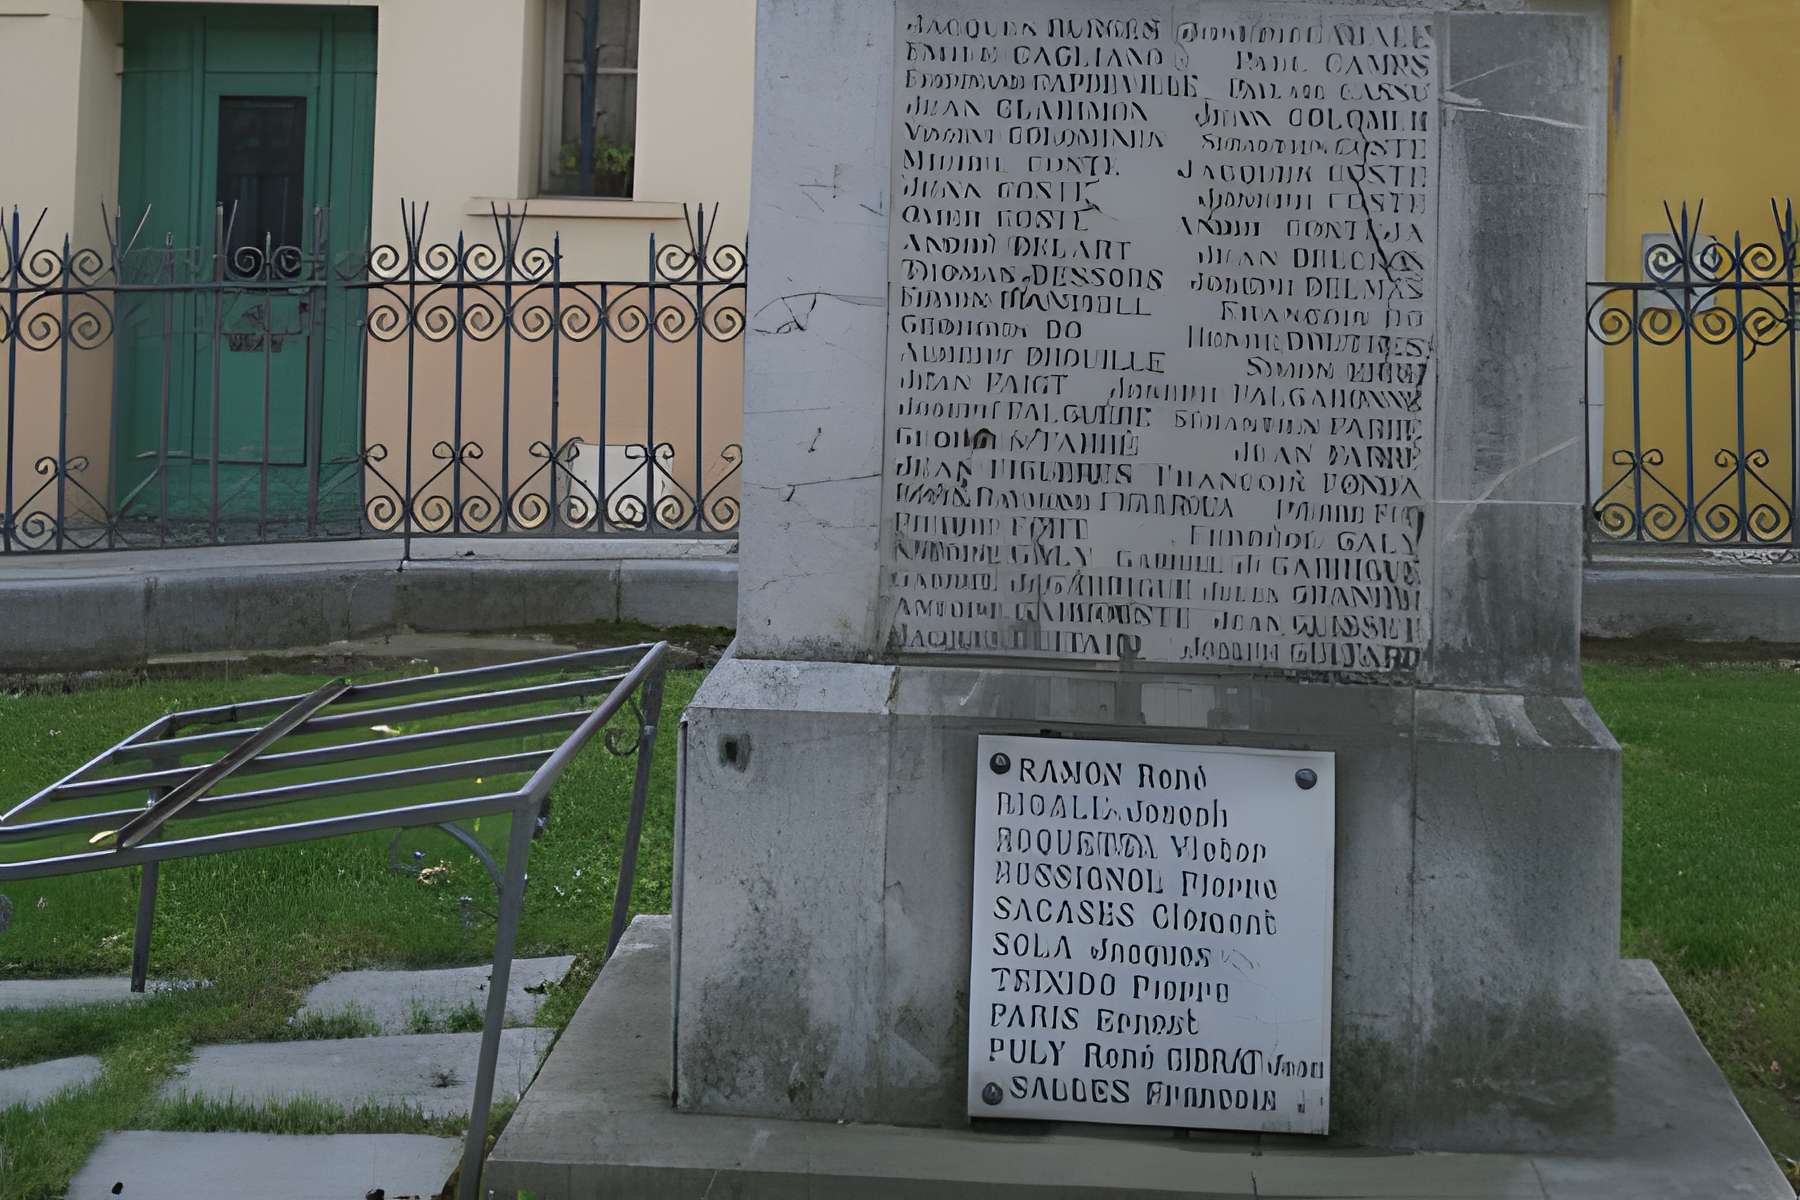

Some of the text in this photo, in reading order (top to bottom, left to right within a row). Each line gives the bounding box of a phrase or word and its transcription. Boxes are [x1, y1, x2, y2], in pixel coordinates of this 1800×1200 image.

[1019, 757, 1123, 787] RAMON
[992, 931, 1072, 961] SOLA
[991, 1003, 1200, 1037] PARIS Ernest
